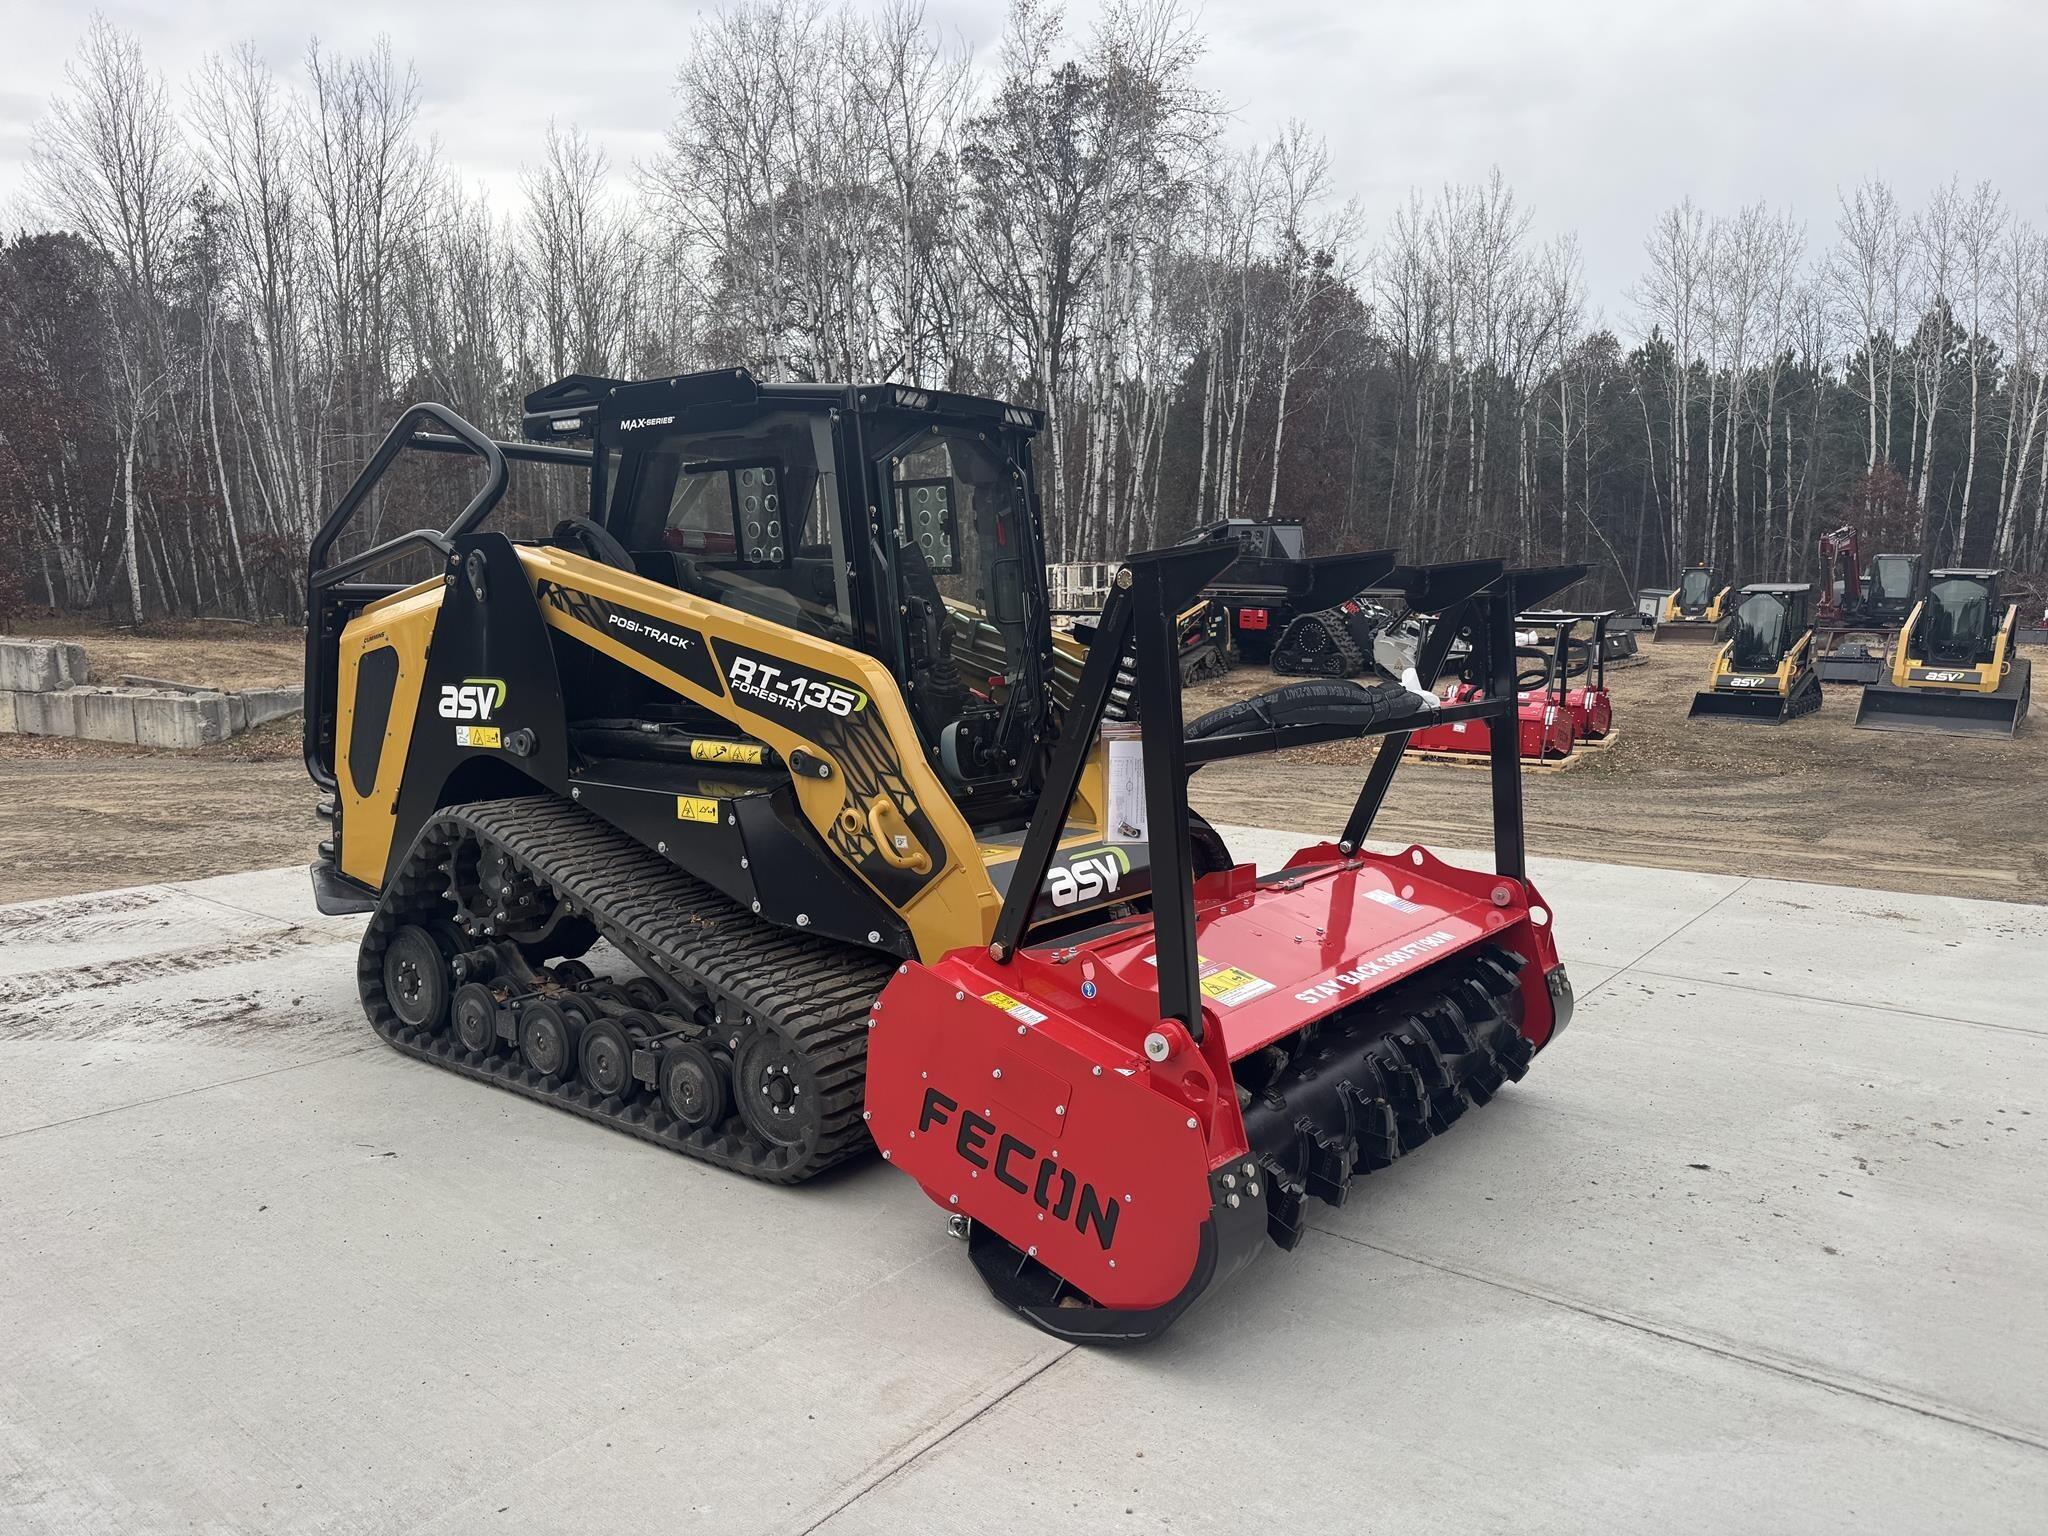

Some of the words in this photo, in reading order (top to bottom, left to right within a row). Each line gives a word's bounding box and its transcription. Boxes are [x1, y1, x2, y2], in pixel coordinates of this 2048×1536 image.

[729, 656, 856, 717] RT-135
[730, 678, 808, 713] FORESTRY
[1294, 979, 1346, 1005] STAY
[1336, 959, 1391, 987] BACK
[918, 1087, 1121, 1251] FECON
